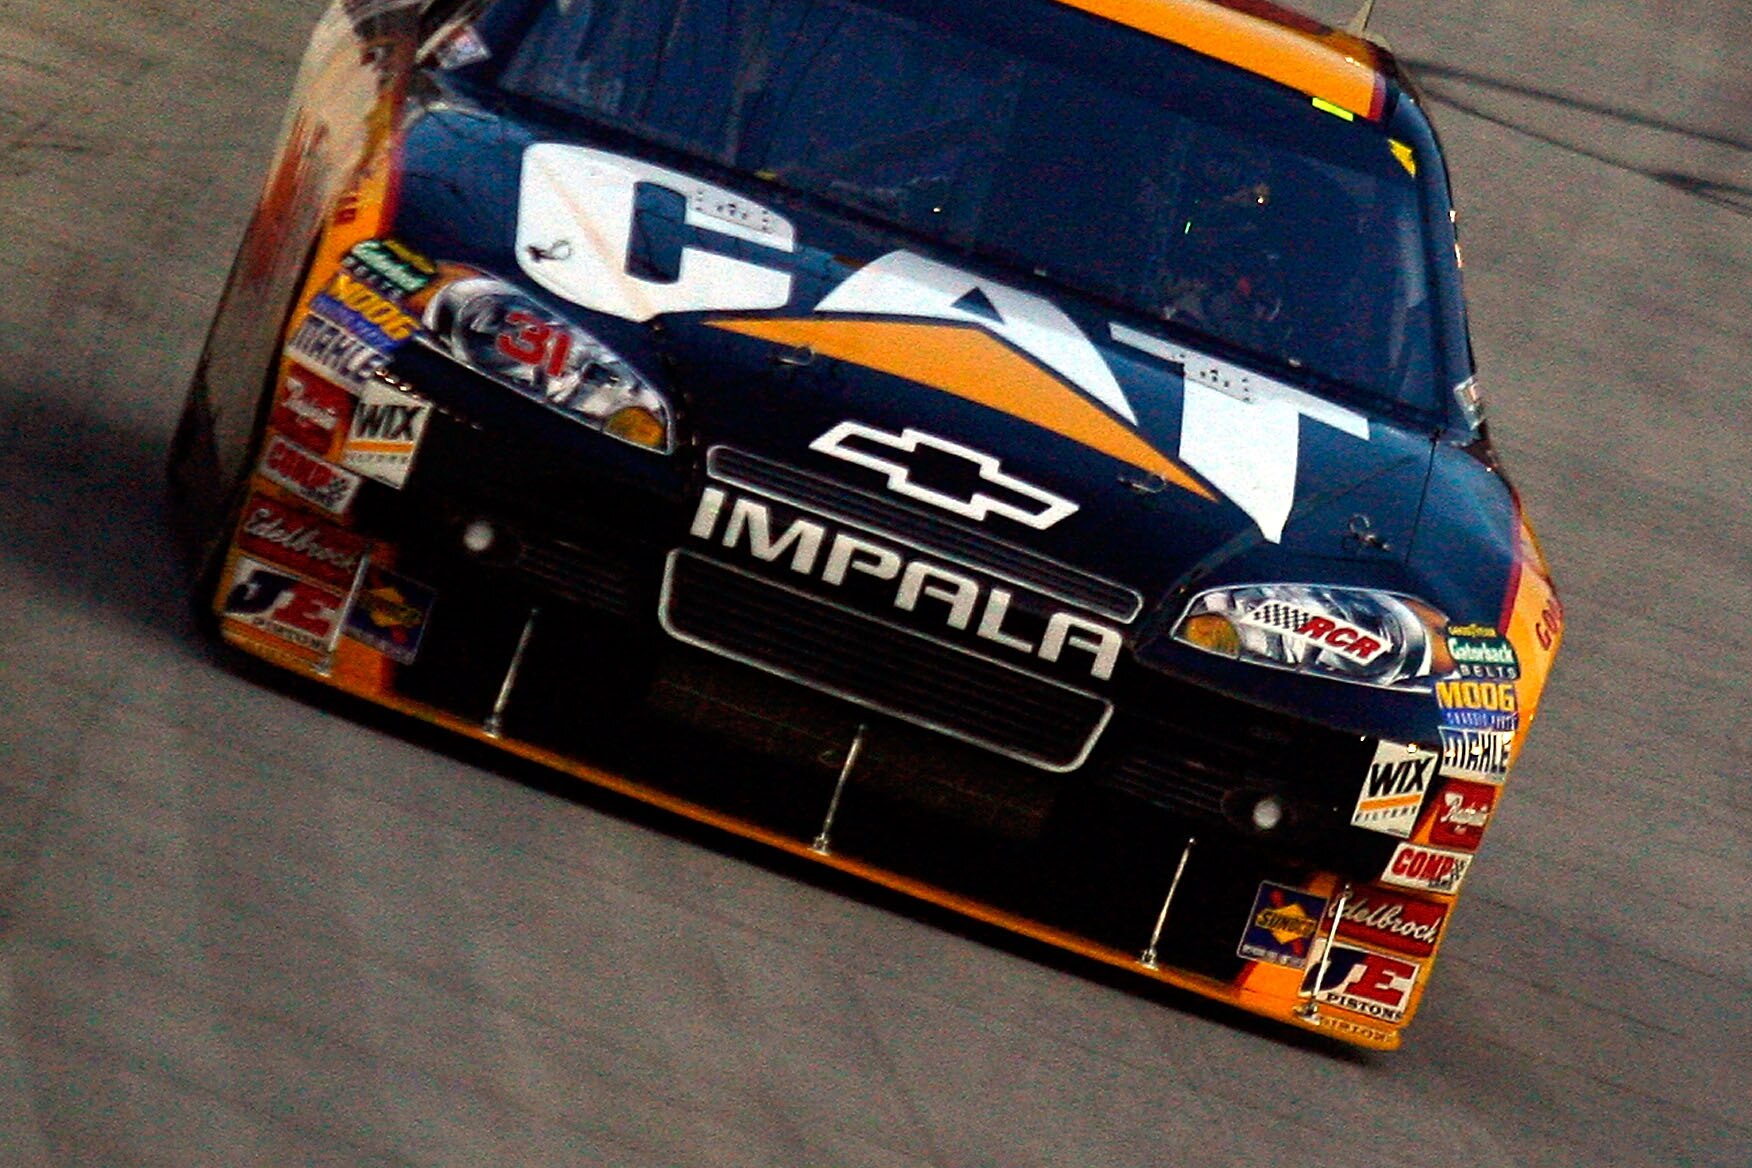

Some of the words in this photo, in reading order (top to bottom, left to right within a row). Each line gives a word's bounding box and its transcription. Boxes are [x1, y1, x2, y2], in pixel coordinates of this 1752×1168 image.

[496, 310, 574, 377] 31
[515, 142, 1371, 545] CAT
[356, 402, 422, 440] WIX
[690, 486, 1123, 681] IMPALA
[1298, 615, 1382, 660] RCR
[1447, 637, 1515, 664] Gatorback
[1459, 663, 1517, 680] BELTS
[1435, 682, 1516, 713] MOOG
[1369, 756, 1435, 798] WIX
[1391, 848, 1455, 882] COMP
[1326, 991, 1404, 1022] PISTONS
